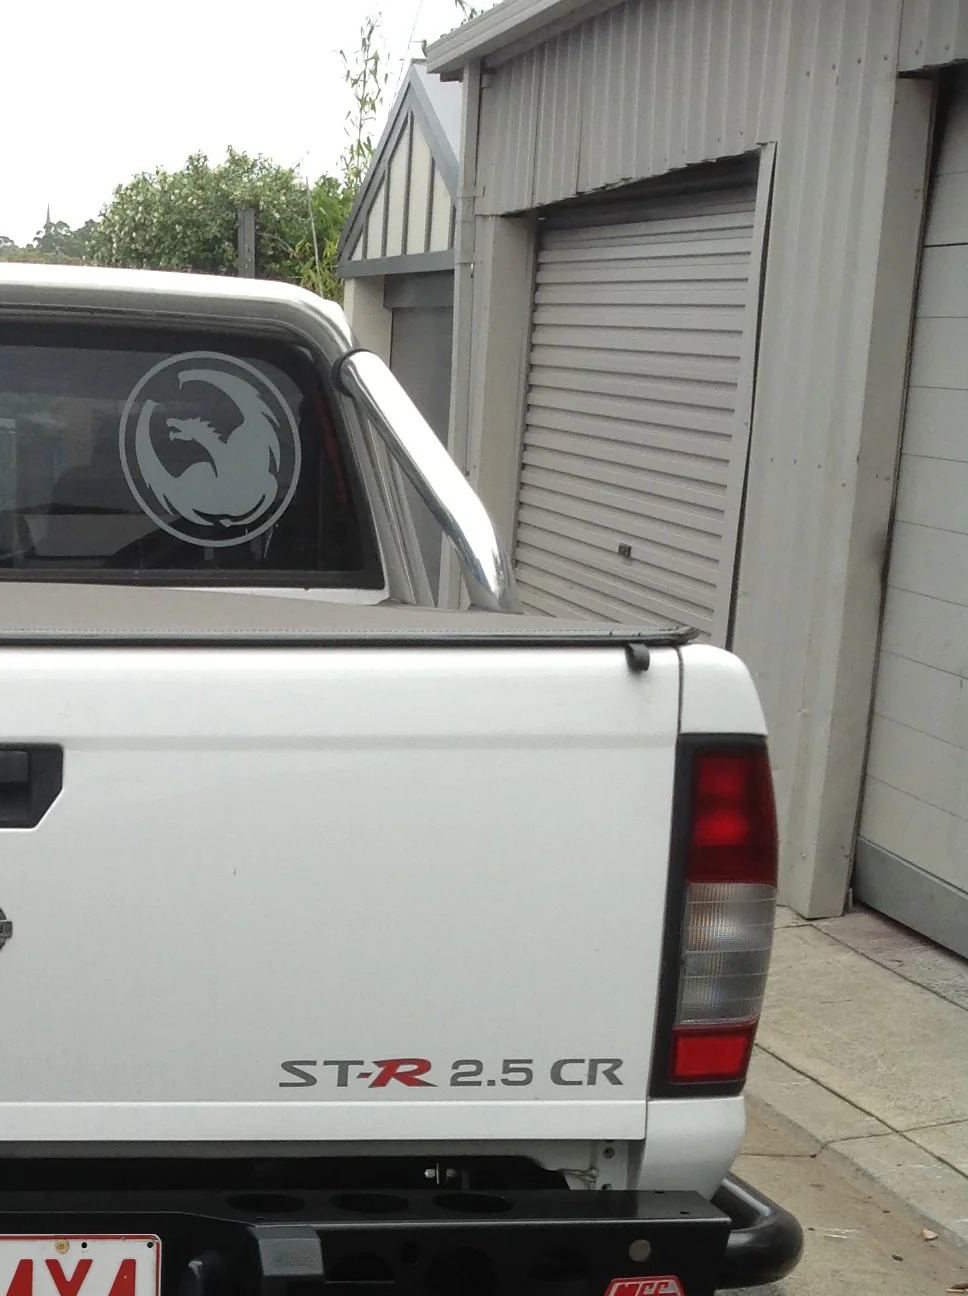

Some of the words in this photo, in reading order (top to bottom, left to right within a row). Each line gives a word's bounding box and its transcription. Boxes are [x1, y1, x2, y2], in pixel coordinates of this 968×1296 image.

[278, 1057, 439, 1089] ST-R
[450, 1058, 534, 1087] 2.5
[550, 1058, 624, 1087] CR
